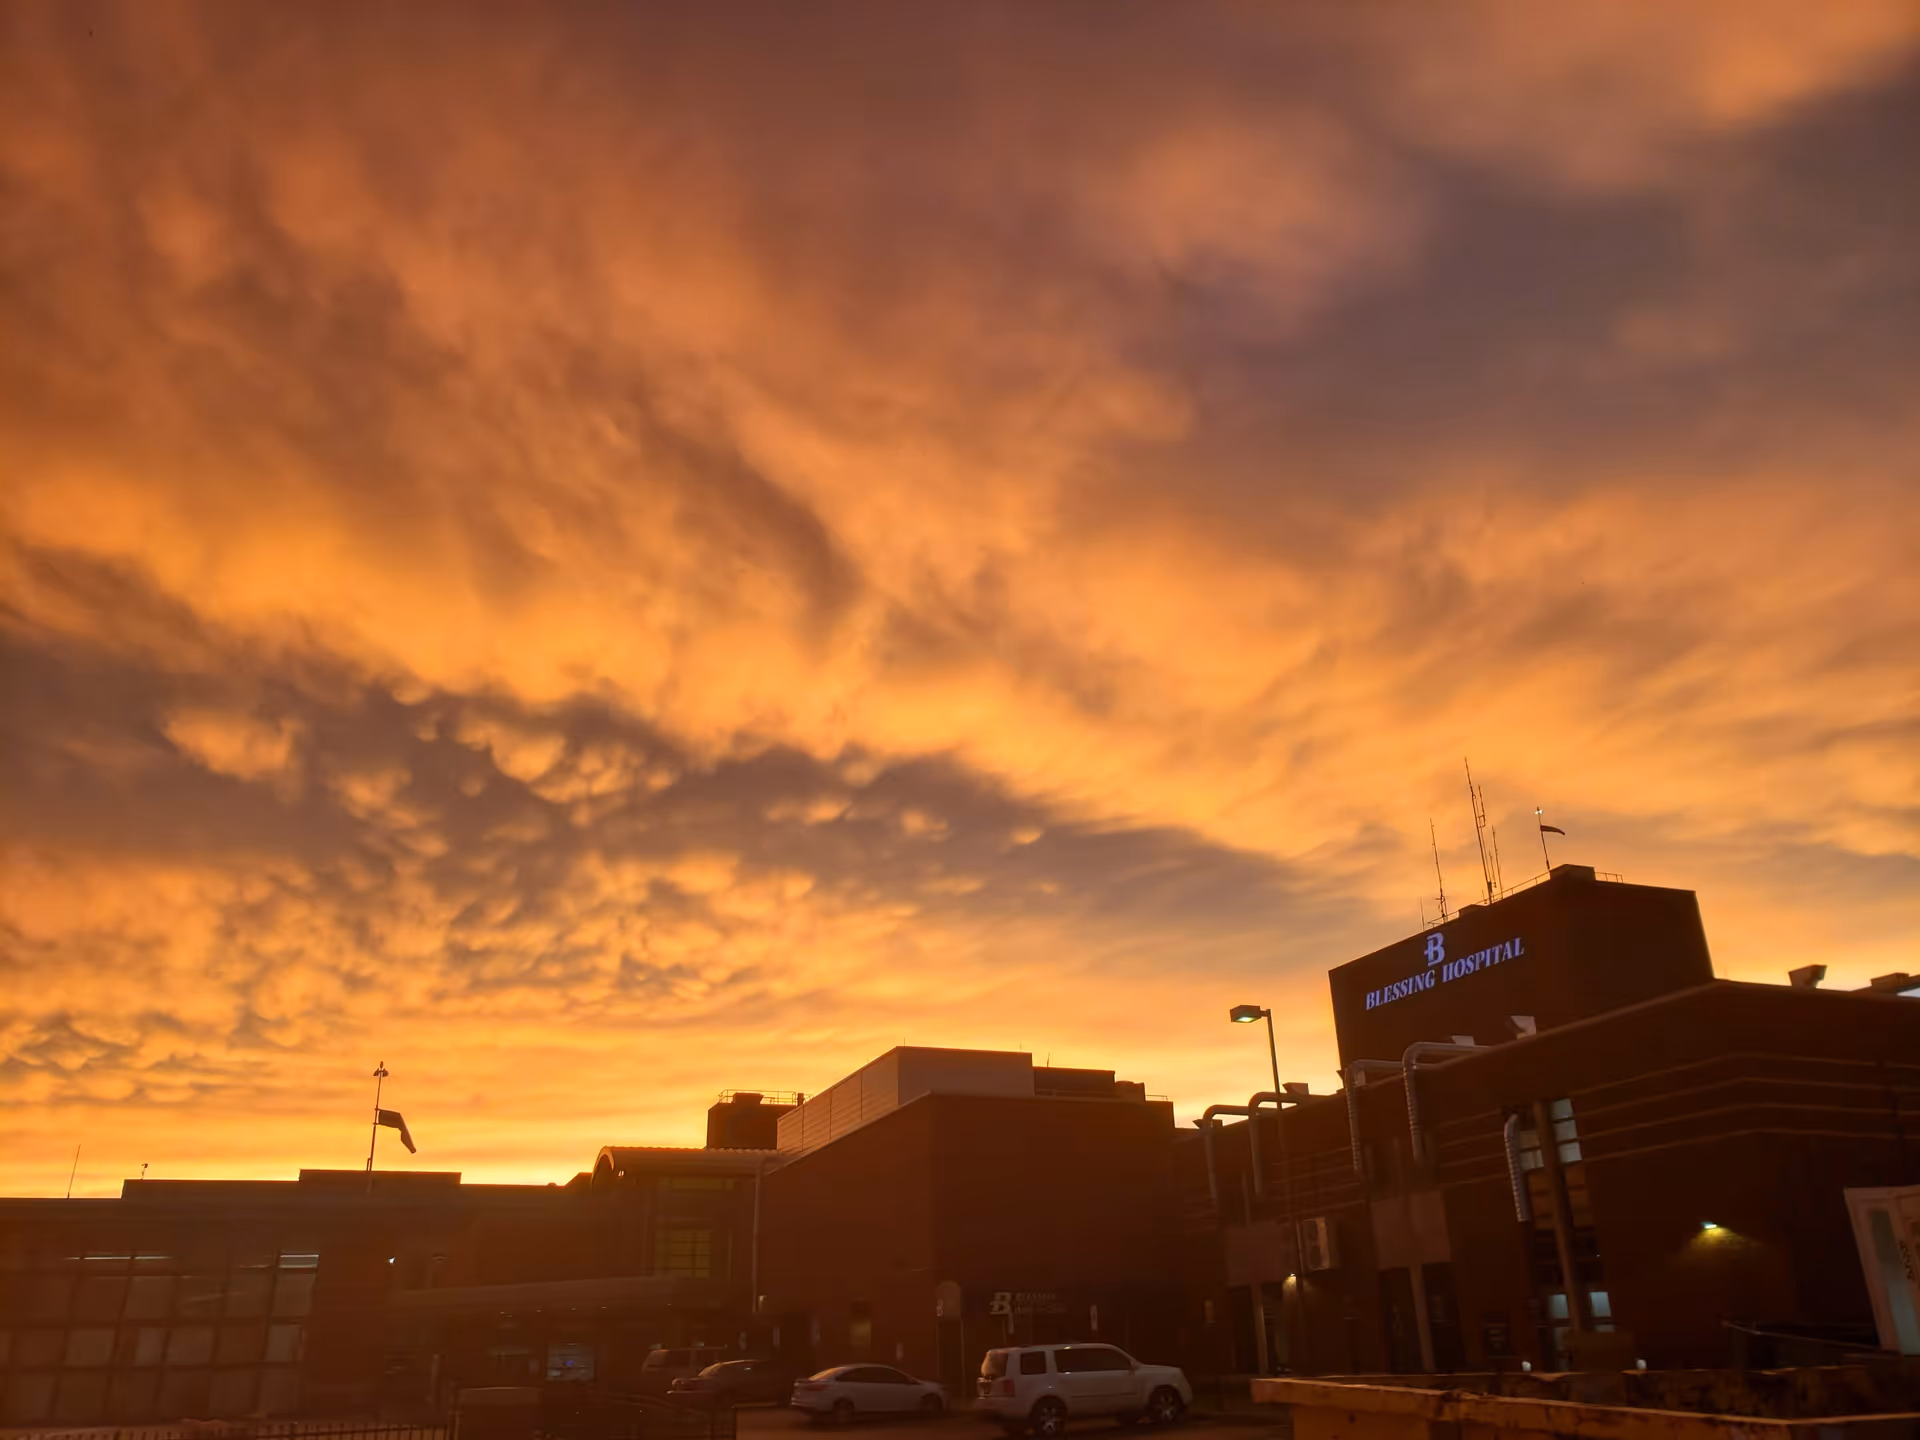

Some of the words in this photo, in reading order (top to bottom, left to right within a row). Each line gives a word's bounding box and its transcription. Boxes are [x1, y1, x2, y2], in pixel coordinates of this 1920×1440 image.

[1365, 969, 1436, 1010] BLESSING
[1442, 937, 1525, 983] HOSPITAL
[1424, 932, 1445, 967] B
